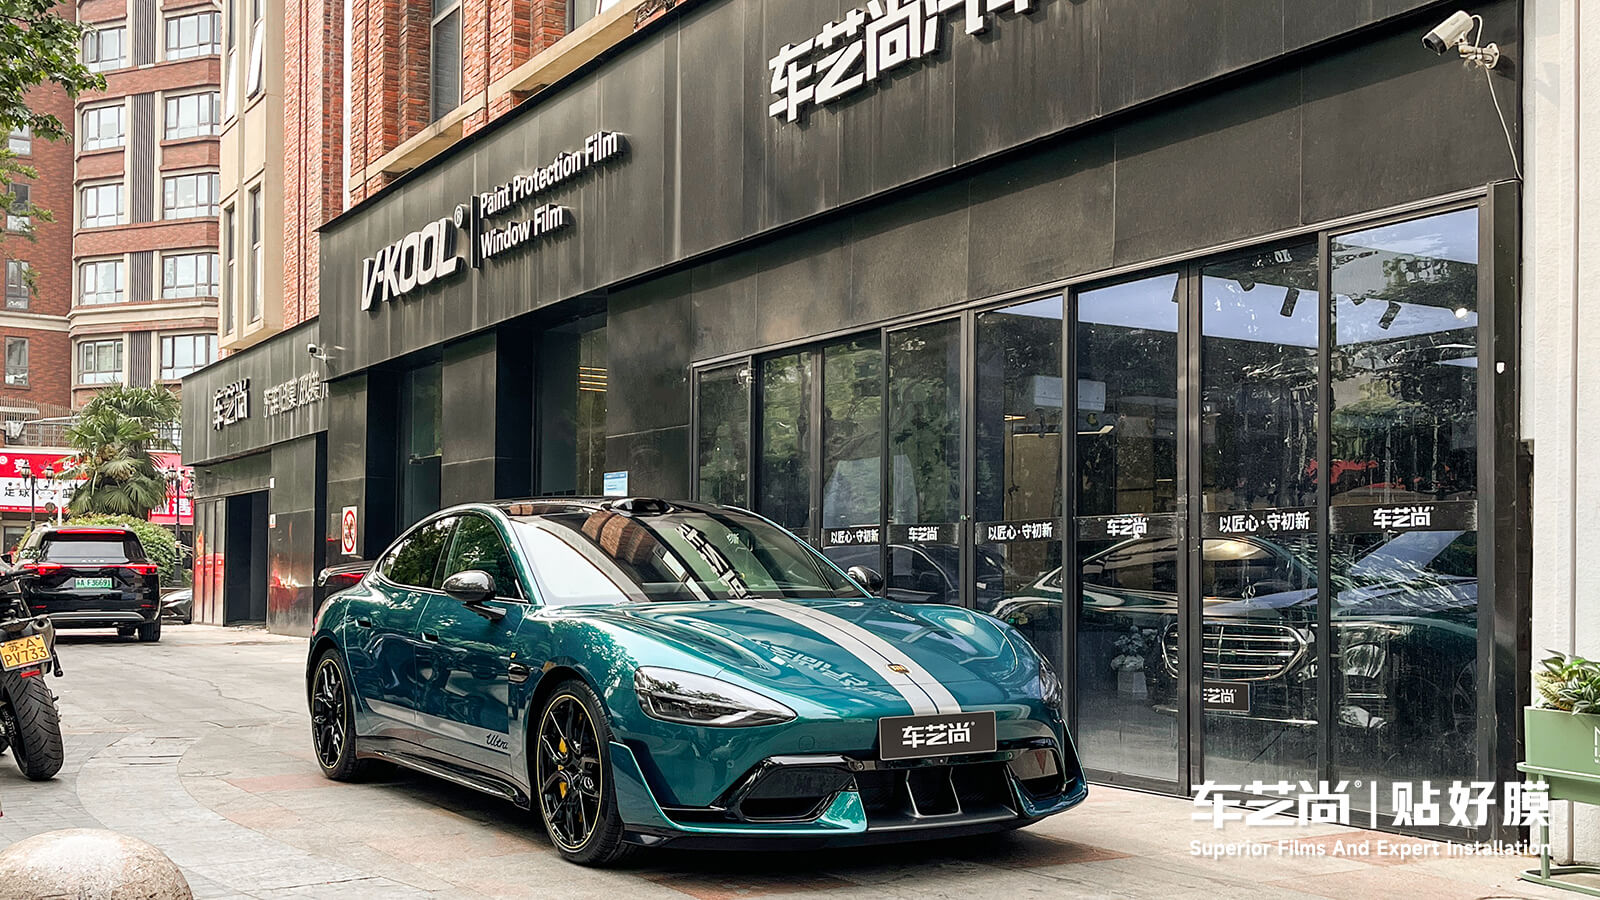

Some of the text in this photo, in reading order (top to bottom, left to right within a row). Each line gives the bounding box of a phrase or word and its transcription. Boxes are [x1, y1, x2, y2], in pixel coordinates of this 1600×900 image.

[480, 131, 618, 219] Paint Protection Film
[480, 203, 563, 259] Window Film
[361, 218, 457, 312] V-KOOL
[213, 378, 250, 431] 车艺尚
[1106, 516, 1149, 537] 车艺尚
[1218, 511, 1311, 534] 以匠心·守初新
[1373, 507, 1434, 528] 车艺尚
[908, 526, 938, 542] 车艺尚
[987, 522, 1053, 541] 以匠心·守初新
[4, 646, 48, 666] PV733
[486, 733, 509, 750] Ultra
[902, 722, 971, 749] 车艺尚
